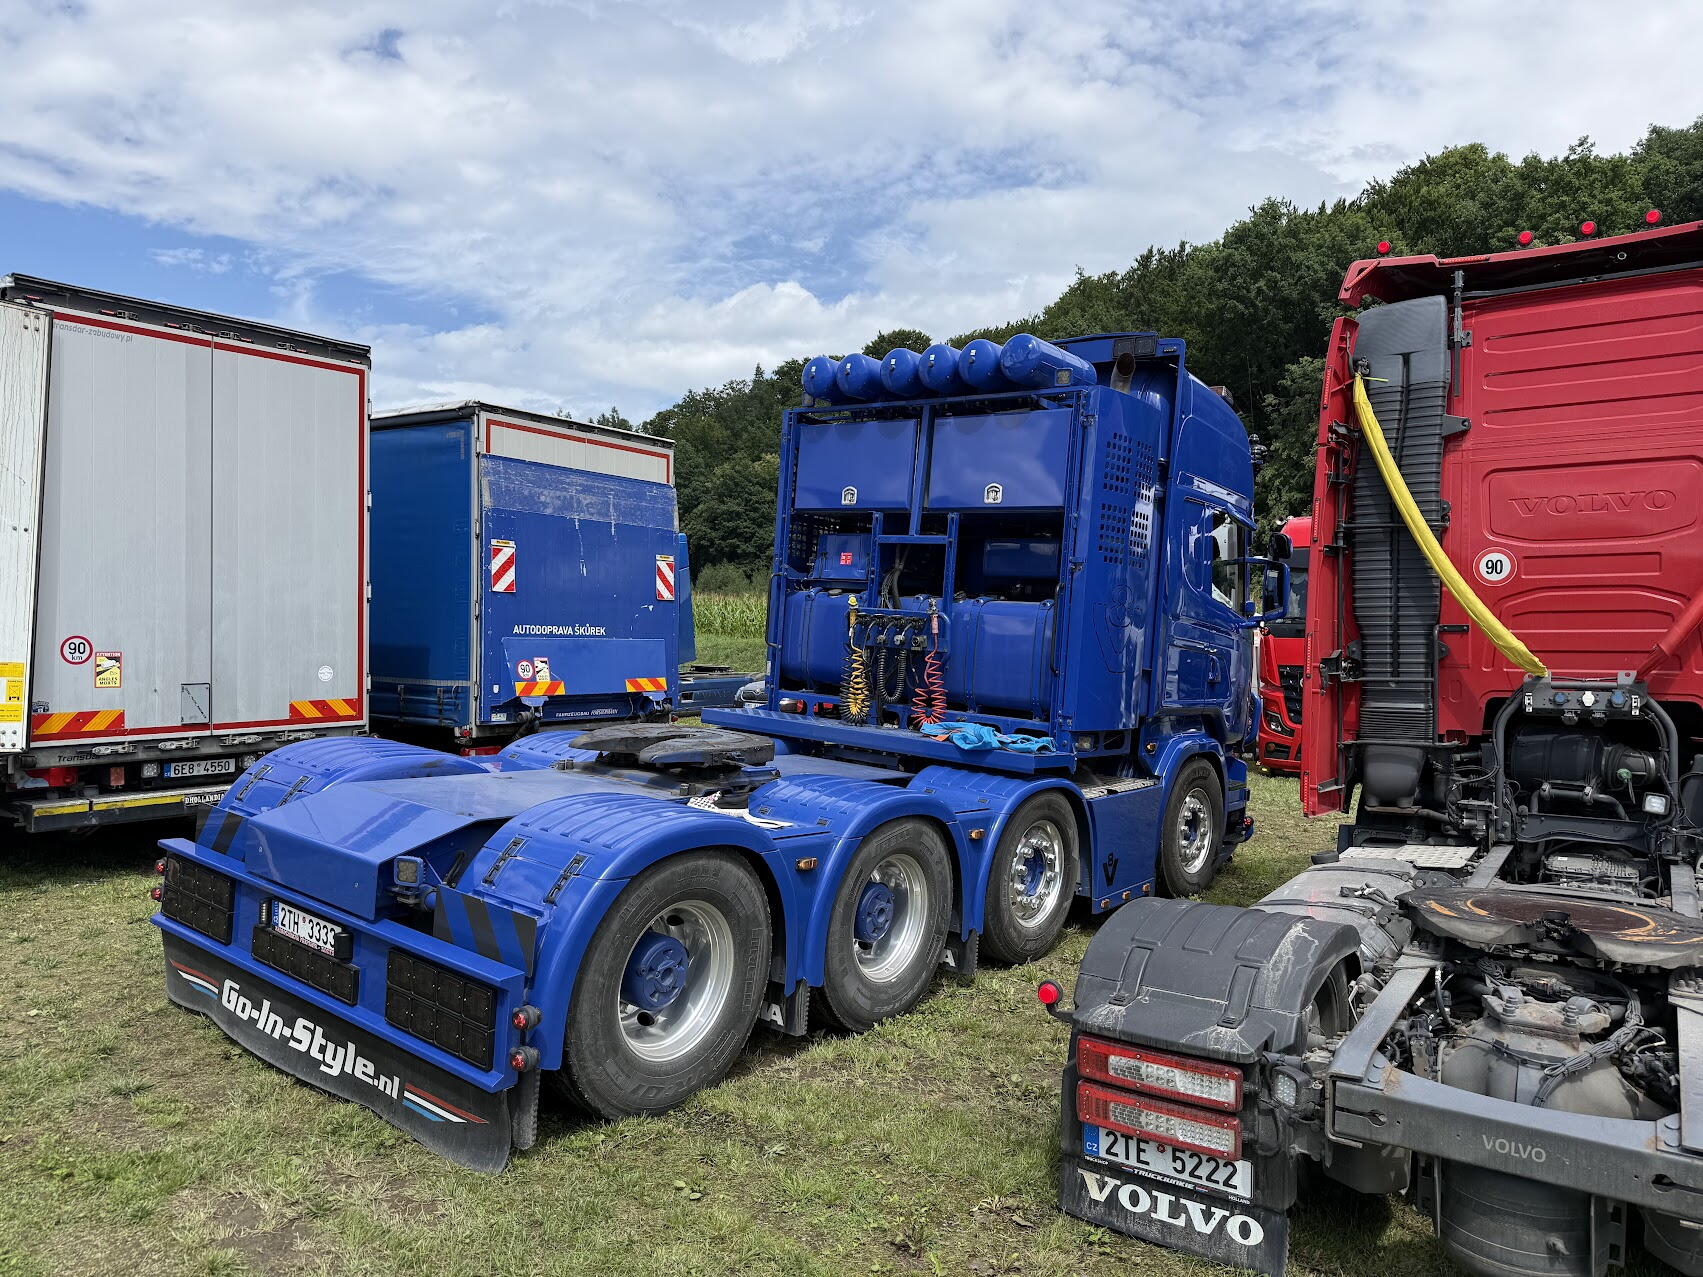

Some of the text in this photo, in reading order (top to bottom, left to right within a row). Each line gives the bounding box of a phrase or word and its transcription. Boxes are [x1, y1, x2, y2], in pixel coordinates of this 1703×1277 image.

[1508, 489, 1677, 517] VOLVO
[1485, 558, 1504, 575] 90
[513, 623, 606, 635] AUTODOPRAVA ŠKŮREK
[68, 641, 86, 655] 90
[520, 664, 531, 673] 90
[173, 763, 195, 776] 6E8
[203, 760, 231, 774] 4550
[280, 907, 300, 934] 2TH
[307, 919, 336, 948] 3333
[221, 978, 400, 1100] Go-In-Style.nl
[1482, 1134, 1546, 1163] VOLVO
[1086, 1130, 1238, 1190] CZ 2TE 5222
[1077, 1167, 1265, 1246] VOLVO
[1228, 1195, 1251, 1205] HOLLAND
